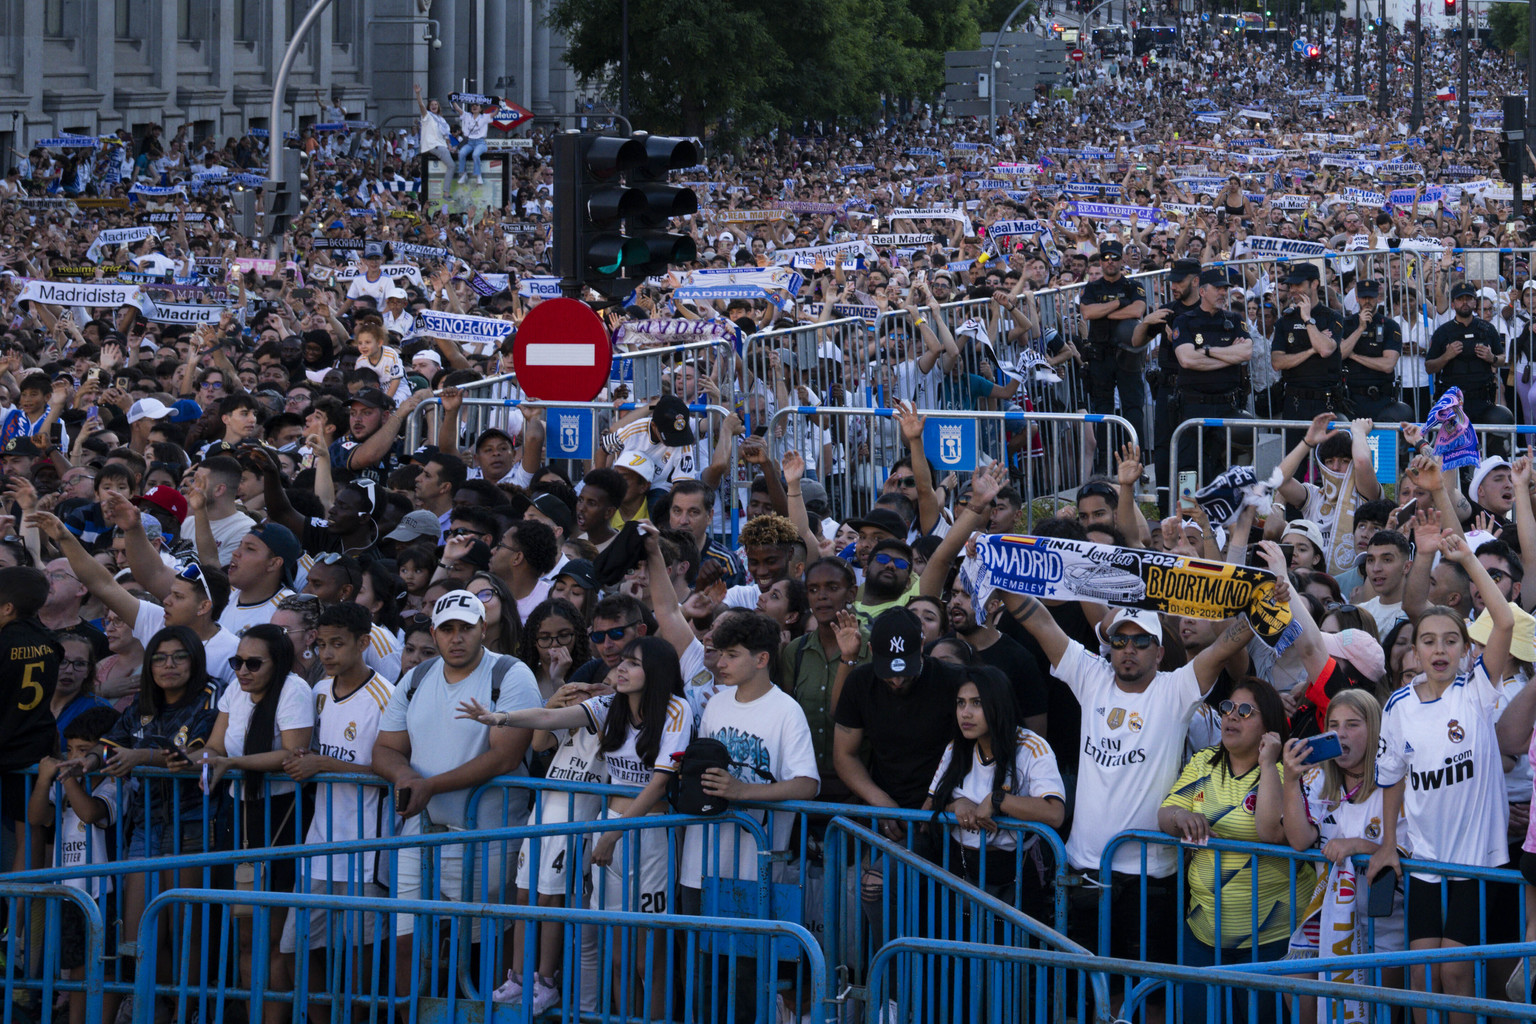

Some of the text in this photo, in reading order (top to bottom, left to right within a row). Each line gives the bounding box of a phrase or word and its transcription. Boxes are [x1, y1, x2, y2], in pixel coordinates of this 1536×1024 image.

[501, 139, 508, 147] de
[510, 139, 530, 149] España
[982, 179, 1011, 188] KROOS
[1361, 196, 1386, 205] MADR
[893, 207, 940, 216] Real Madrid
[1078, 204, 1103, 214] REAL
[149, 212, 172, 223] REAL
[1015, 220, 1038, 233] Mad
[329, 238, 364, 247] BECKHAM
[872, 234, 896, 245] Real
[1251, 238, 1325, 255] REAL MADRID
[381, 265, 416, 277] ADRID
[39, 284, 127, 304] Madridista
[678, 289, 767, 298] MADRIDISTA
[158, 307, 211, 322] Madrid
[426, 316, 516, 337] CAMPEONES
[1040, 539, 1185, 569] FINAL London 2024
[992, 576, 1046, 595] WEMBLEY
[435, 594, 474, 615] UFC
[1170, 604, 1224, 620] 01-06-2024
[17, 660, 45, 711] 5
[1083, 735, 1147, 767] Emirates
[1101, 736, 1122, 752] Fly
[568, 756, 588, 770] Fly
[606, 755, 655, 773] mirate
[549, 766, 603, 784] Emirates
[621, 770, 650, 783] BETTER
[1409, 757, 1474, 792] bwin
[62, 839, 88, 853] rates
[62, 852, 81, 863] ETTER
[551, 849, 566, 874] 4
[641, 890, 666, 914] 20
